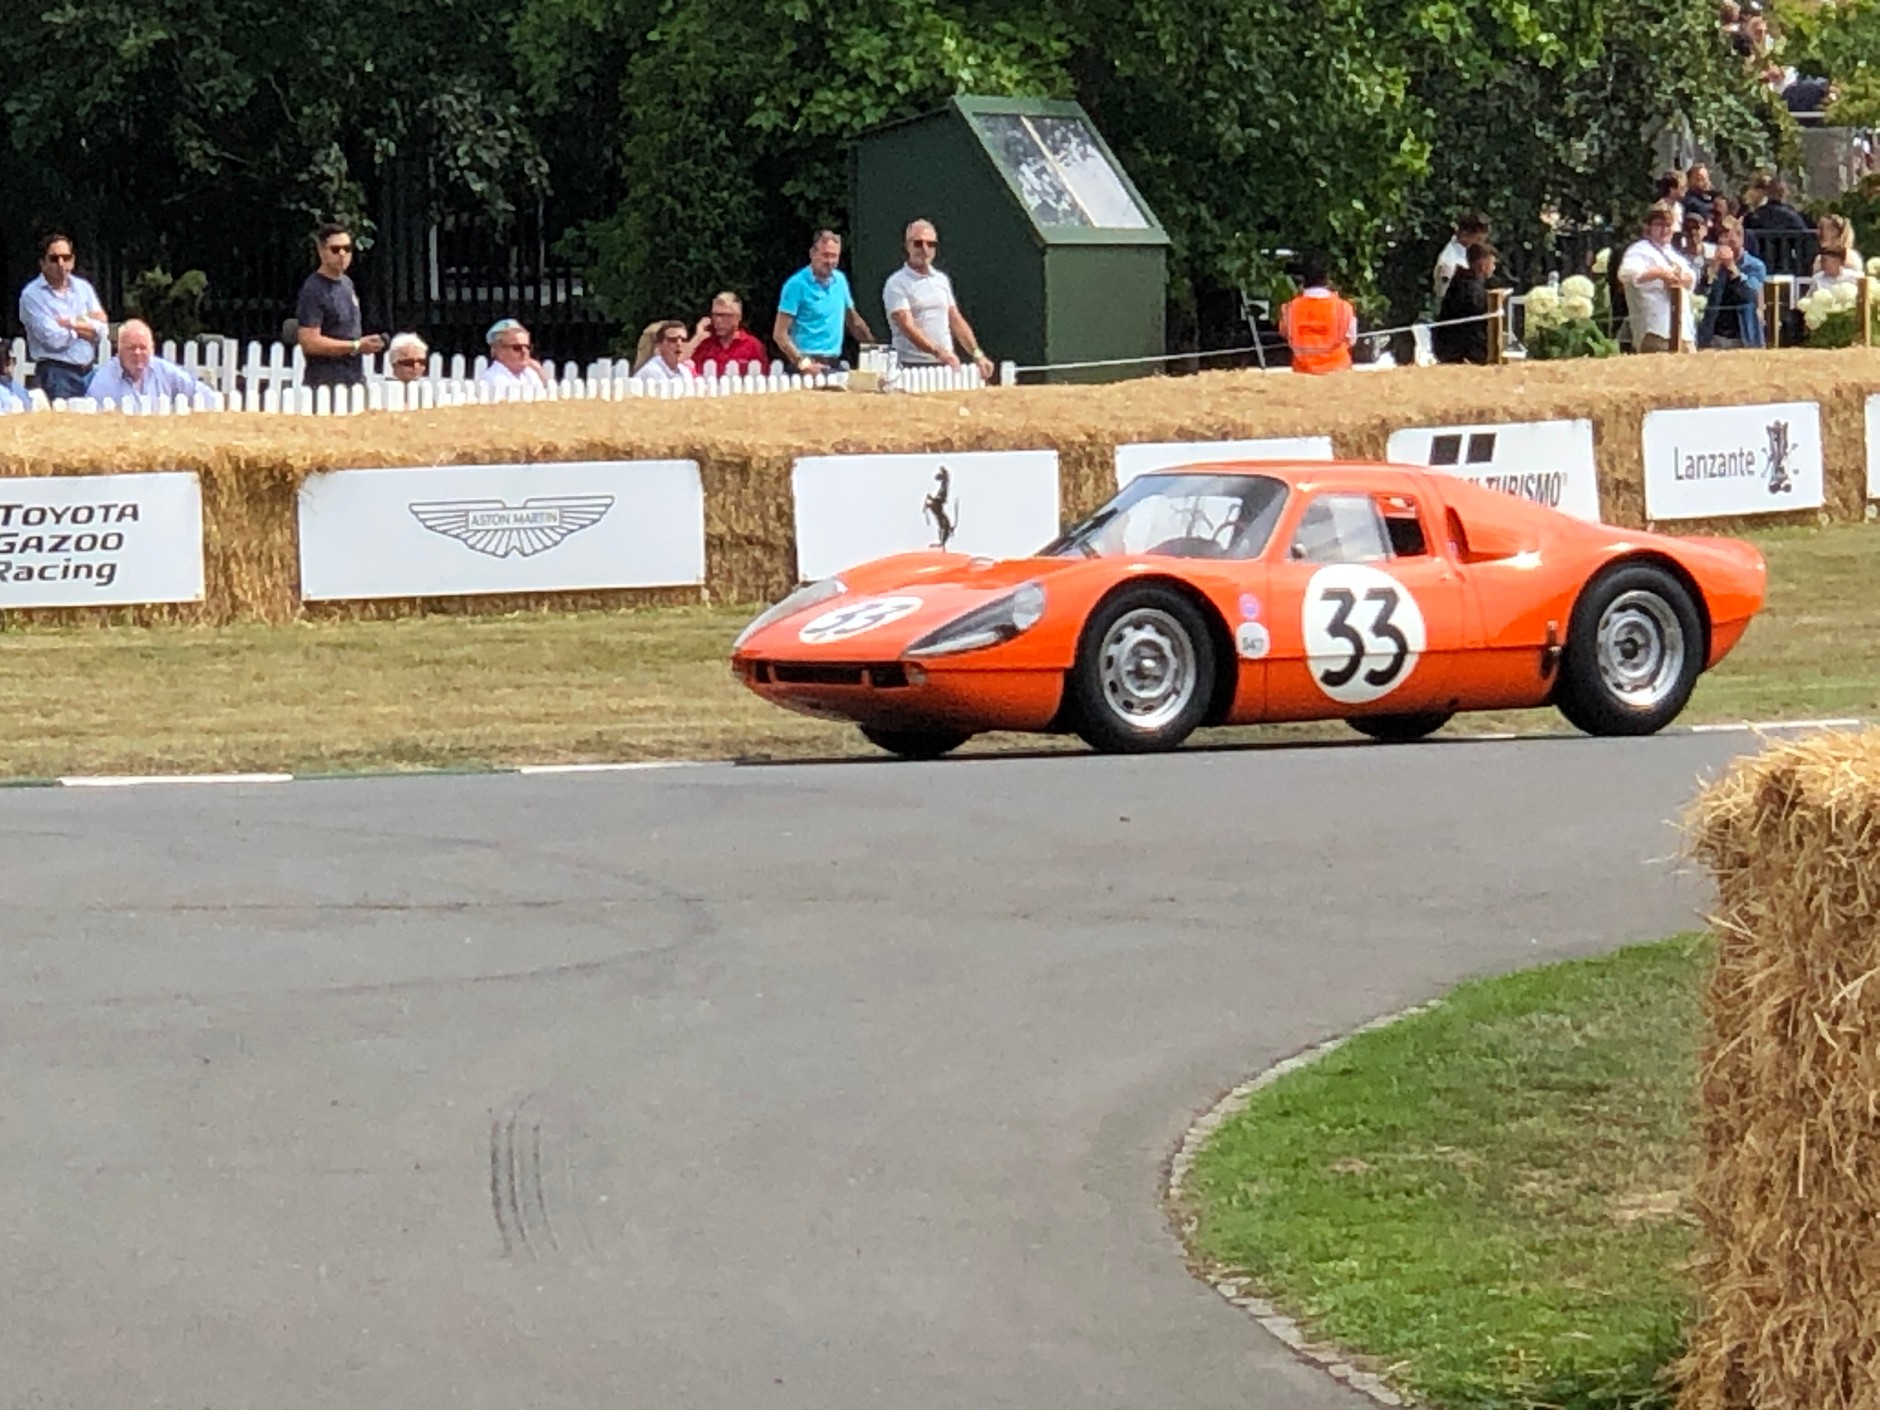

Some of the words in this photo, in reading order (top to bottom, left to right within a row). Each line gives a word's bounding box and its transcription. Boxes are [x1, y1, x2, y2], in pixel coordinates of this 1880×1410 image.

[1674, 447, 1756, 481] Lanzante
[0, 504, 139, 526] TOYOTA
[471, 513, 511, 526] ASTON
[513, 511, 557, 524] MARTIN
[0, 532, 124, 554] GAZOO
[804, 603, 915, 635] 33
[1320, 587, 1409, 687] 33
